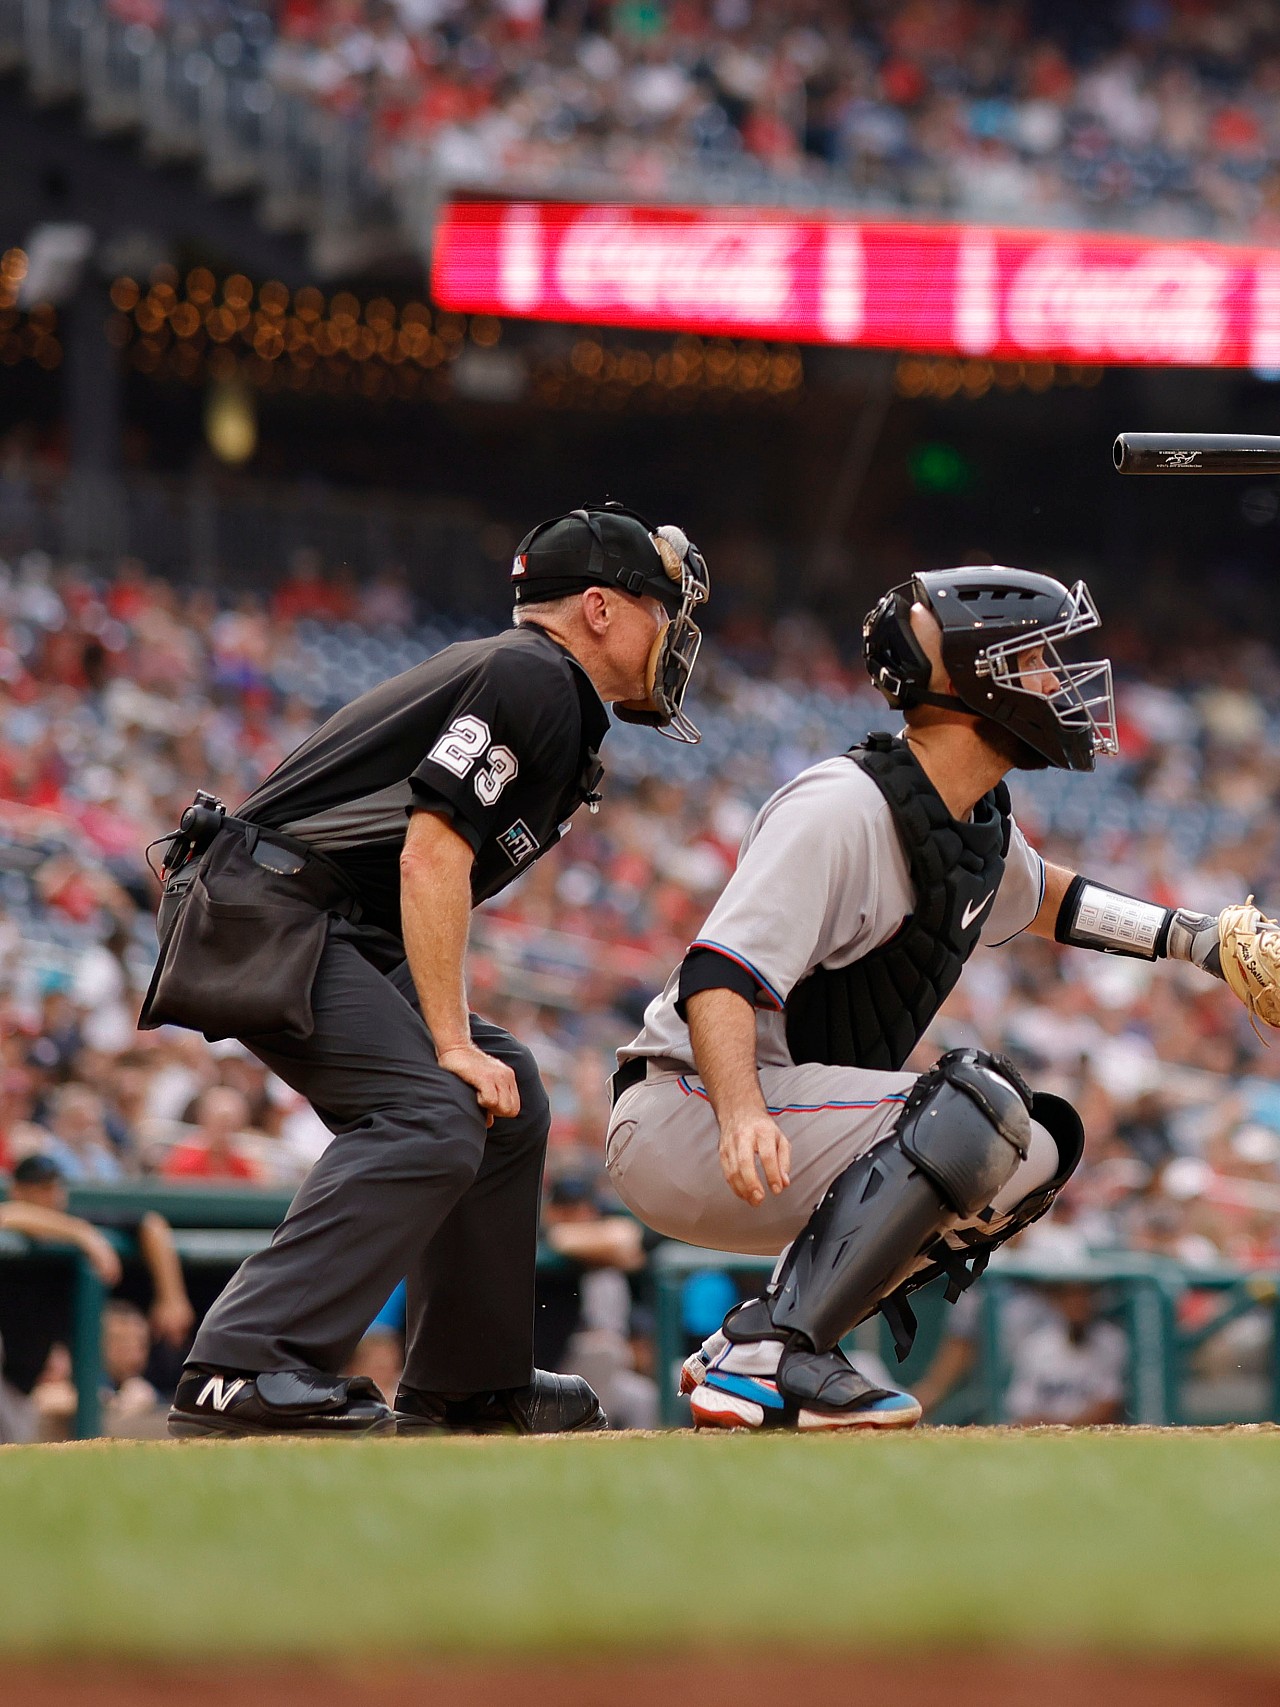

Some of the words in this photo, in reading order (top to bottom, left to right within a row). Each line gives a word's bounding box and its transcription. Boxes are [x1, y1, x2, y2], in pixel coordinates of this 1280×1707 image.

[427, 714, 519, 807] 23
[507, 832, 535, 861] FTX
[195, 1375, 247, 1412] N
